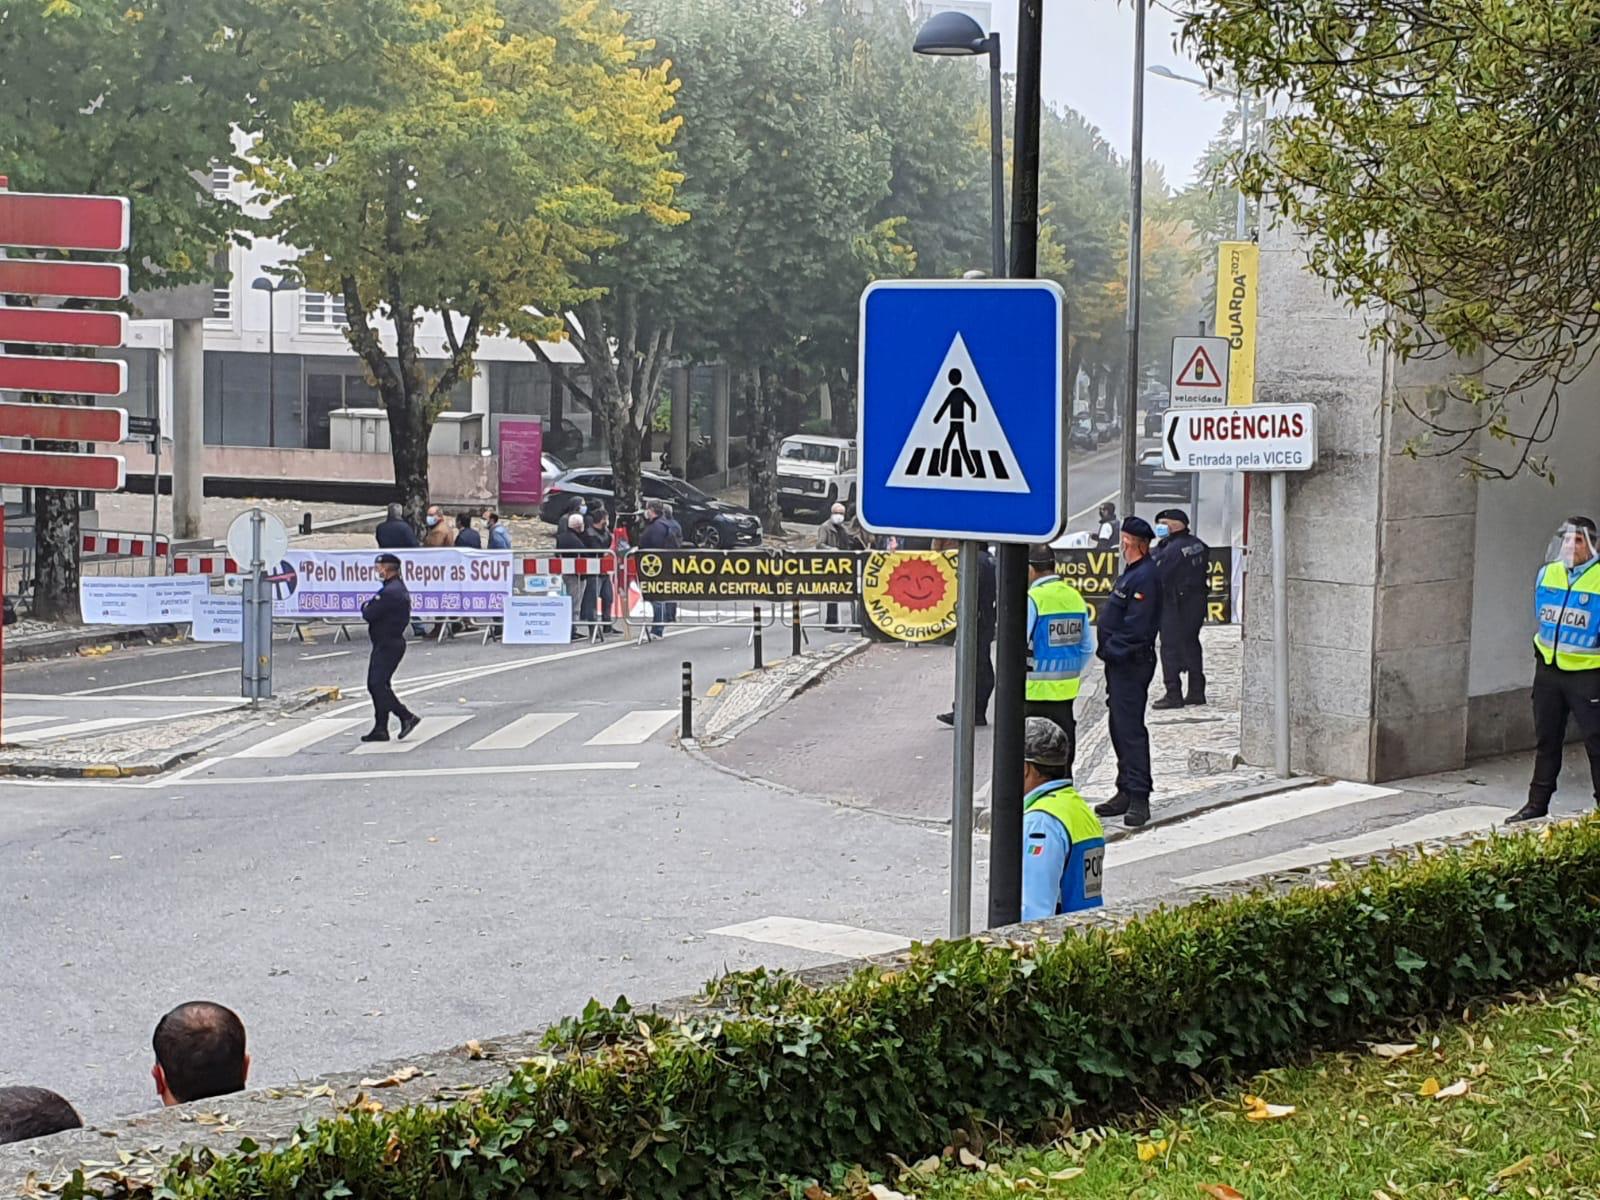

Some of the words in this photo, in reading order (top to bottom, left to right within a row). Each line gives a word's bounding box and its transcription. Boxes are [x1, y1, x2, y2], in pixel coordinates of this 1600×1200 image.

[1228, 274, 1247, 350] GUARDA
[1174, 394, 1223, 404] velocidade
[1189, 411, 1304, 441] URGÊNCIAS
[1188, 453, 1232, 466] Entrada
[1236, 454, 1260, 468] pela
[1263, 451, 1303, 465] VICEG
[405, 560, 446, 586] Repor
[451, 565, 466, 581] as
[471, 560, 511, 581] SCUT
[672, 555, 715, 575] NÃO
[720, 558, 750, 575] AO
[756, 557, 853, 576] NUCLEAR
[640, 581, 704, 594] ENCERRAR
[708, 582, 717, 594] A
[719, 581, 773, 595] CENTRAL
[776, 581, 793, 594] DE
[796, 581, 853, 595] ALMARAZ
